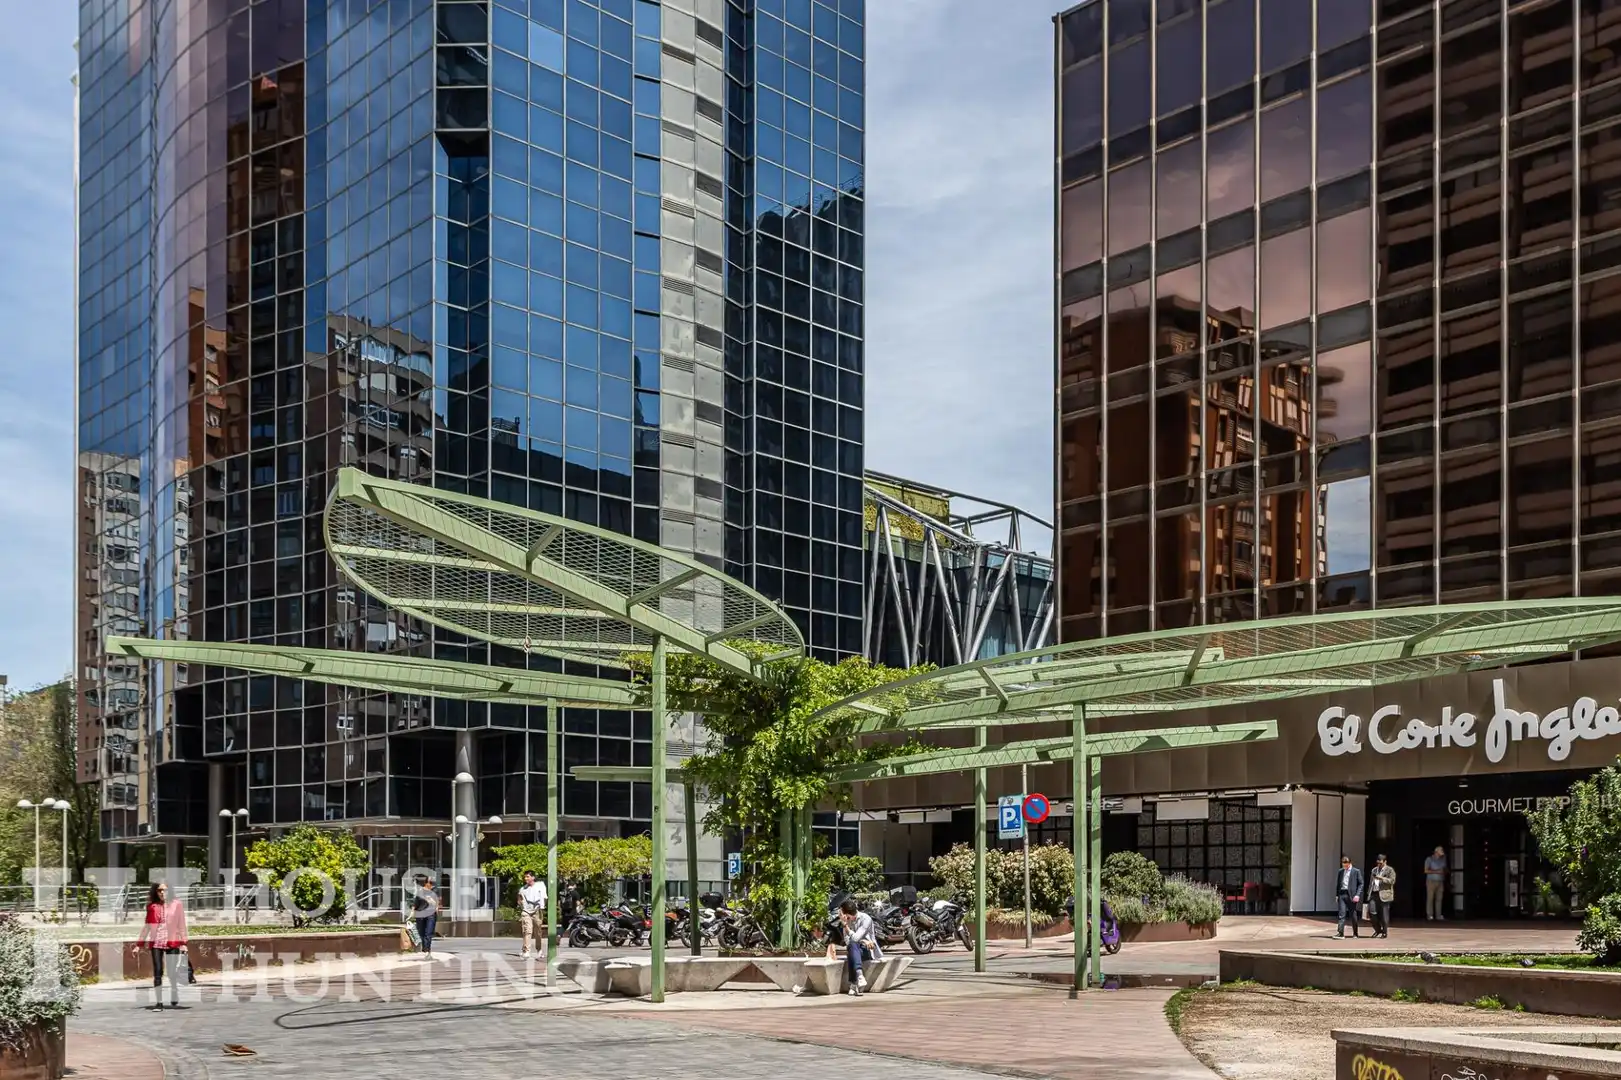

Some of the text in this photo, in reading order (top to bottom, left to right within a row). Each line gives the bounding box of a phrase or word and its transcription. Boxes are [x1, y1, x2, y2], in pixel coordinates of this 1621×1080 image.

[1317, 706, 1362, 756] El
[1368, 704, 1477, 754] Corte
[1447, 797, 1534, 815] GOURMET
[1002, 808, 1016, 828] P
[731, 861, 737, 872] P
